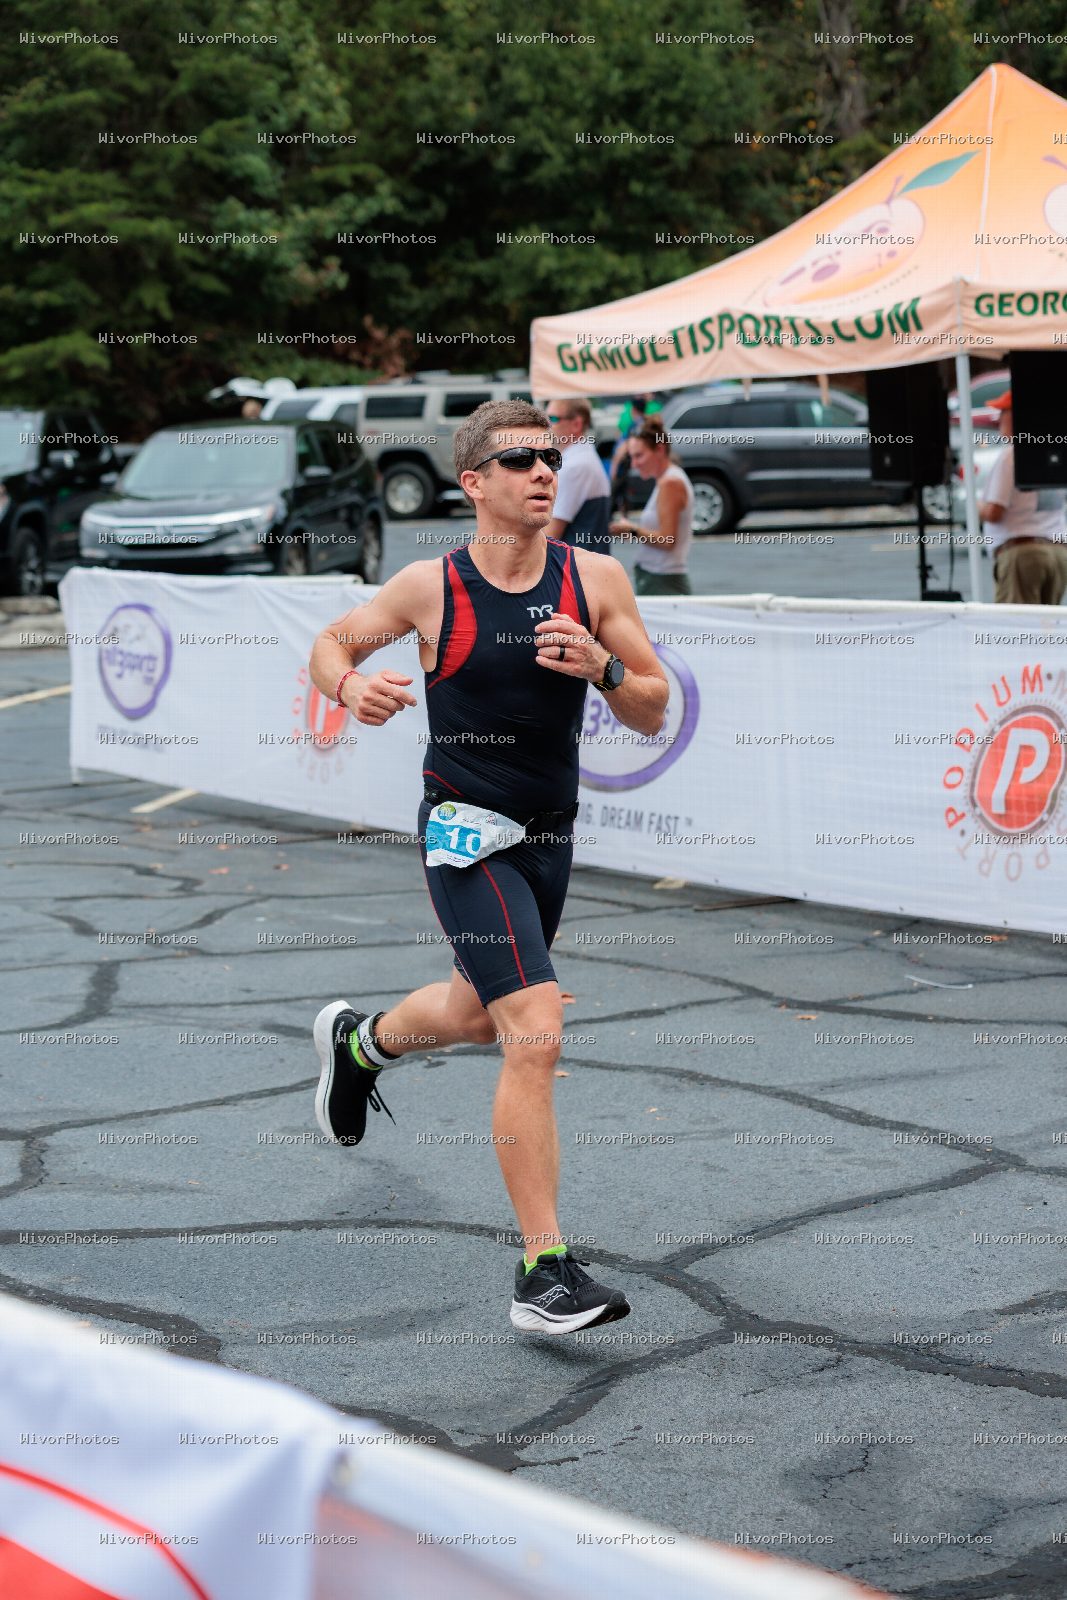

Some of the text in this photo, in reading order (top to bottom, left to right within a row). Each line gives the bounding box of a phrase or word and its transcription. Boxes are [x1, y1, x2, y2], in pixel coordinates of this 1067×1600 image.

[974, 290, 1067, 318] GEOR
[526, 604, 554, 619] TYR
[600, 804, 644, 833] DREAM
[646, 811, 680, 837] FAST
